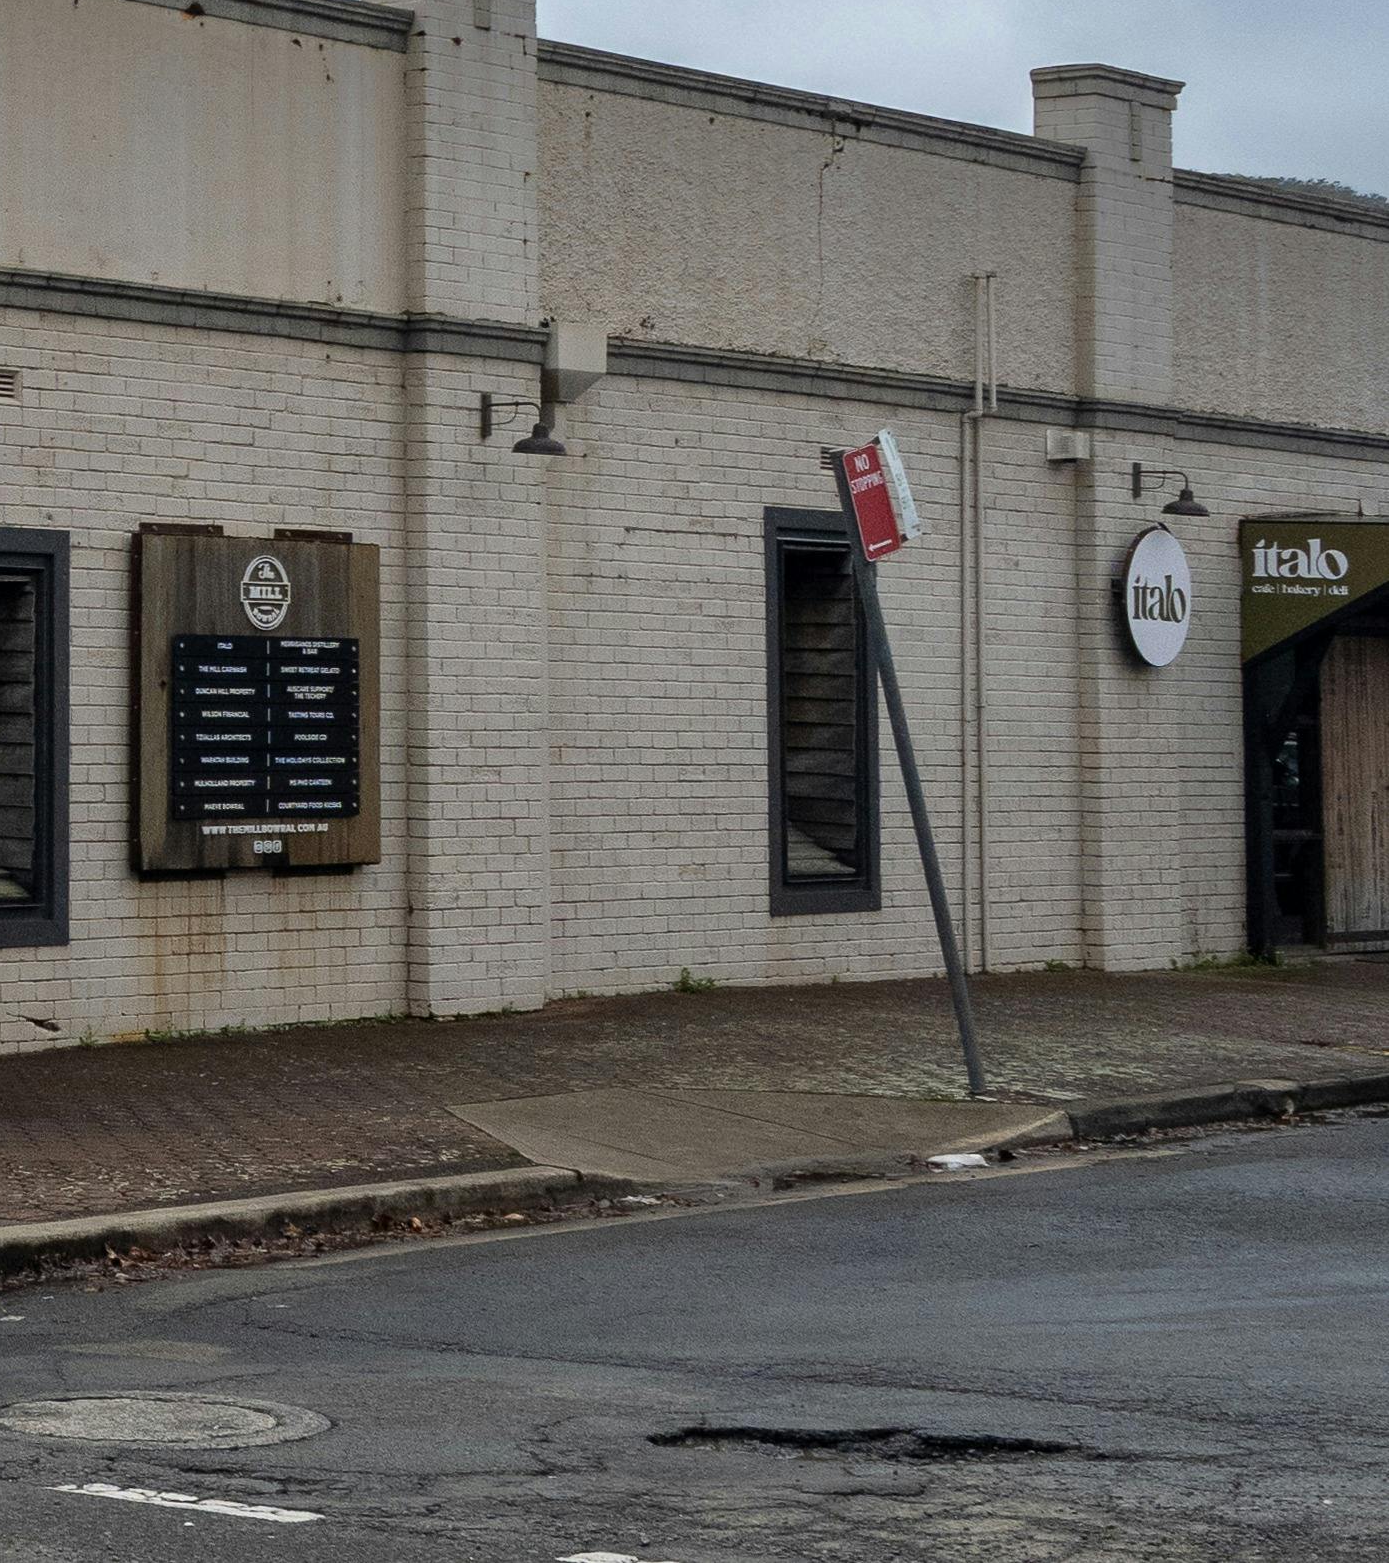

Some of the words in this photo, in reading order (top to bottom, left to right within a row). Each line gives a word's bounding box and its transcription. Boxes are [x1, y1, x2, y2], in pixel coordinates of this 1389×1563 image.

[853, 453, 870, 473] NO
[850, 470, 884, 494] STOPPING
[248, 586, 283, 599] MILL
[1282, 584, 1322, 597] bakery
[1328, 584, 1349, 596] deli
[229, 779, 256, 787] PROPERTY
